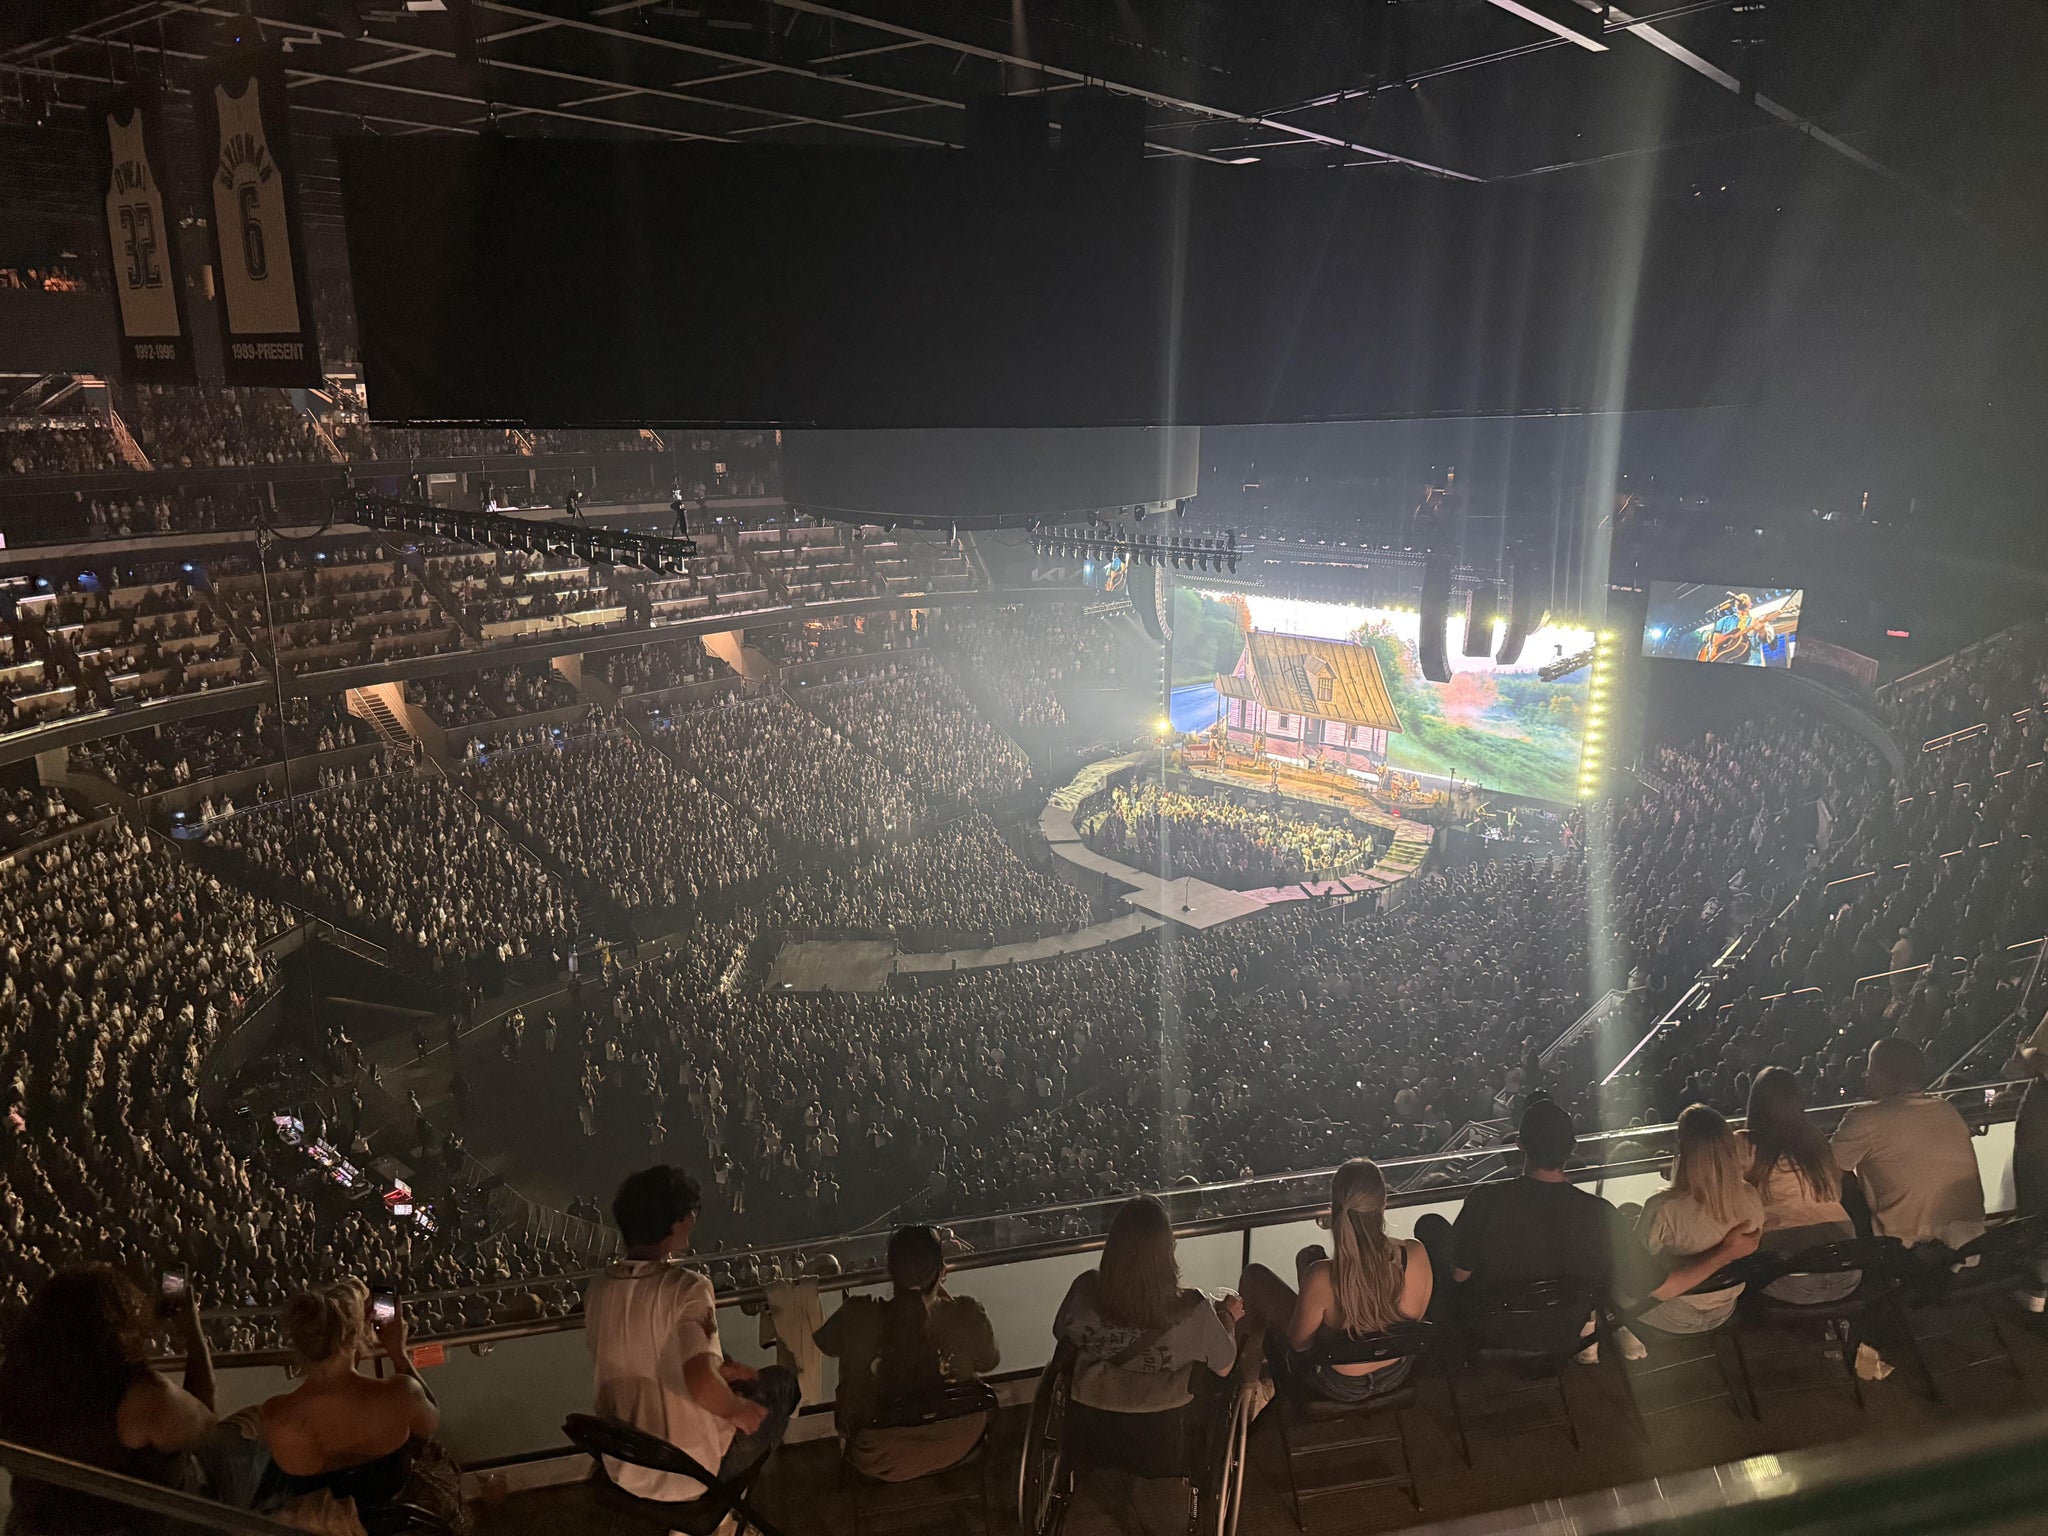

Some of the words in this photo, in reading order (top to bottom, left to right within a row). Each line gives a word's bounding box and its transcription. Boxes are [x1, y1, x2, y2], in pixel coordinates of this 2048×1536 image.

[118, 203, 163, 290] 32
[237, 180, 268, 281] 6
[134, 343, 176, 360] 1992-1996
[231, 342, 304, 360] 1989-PRESENT
